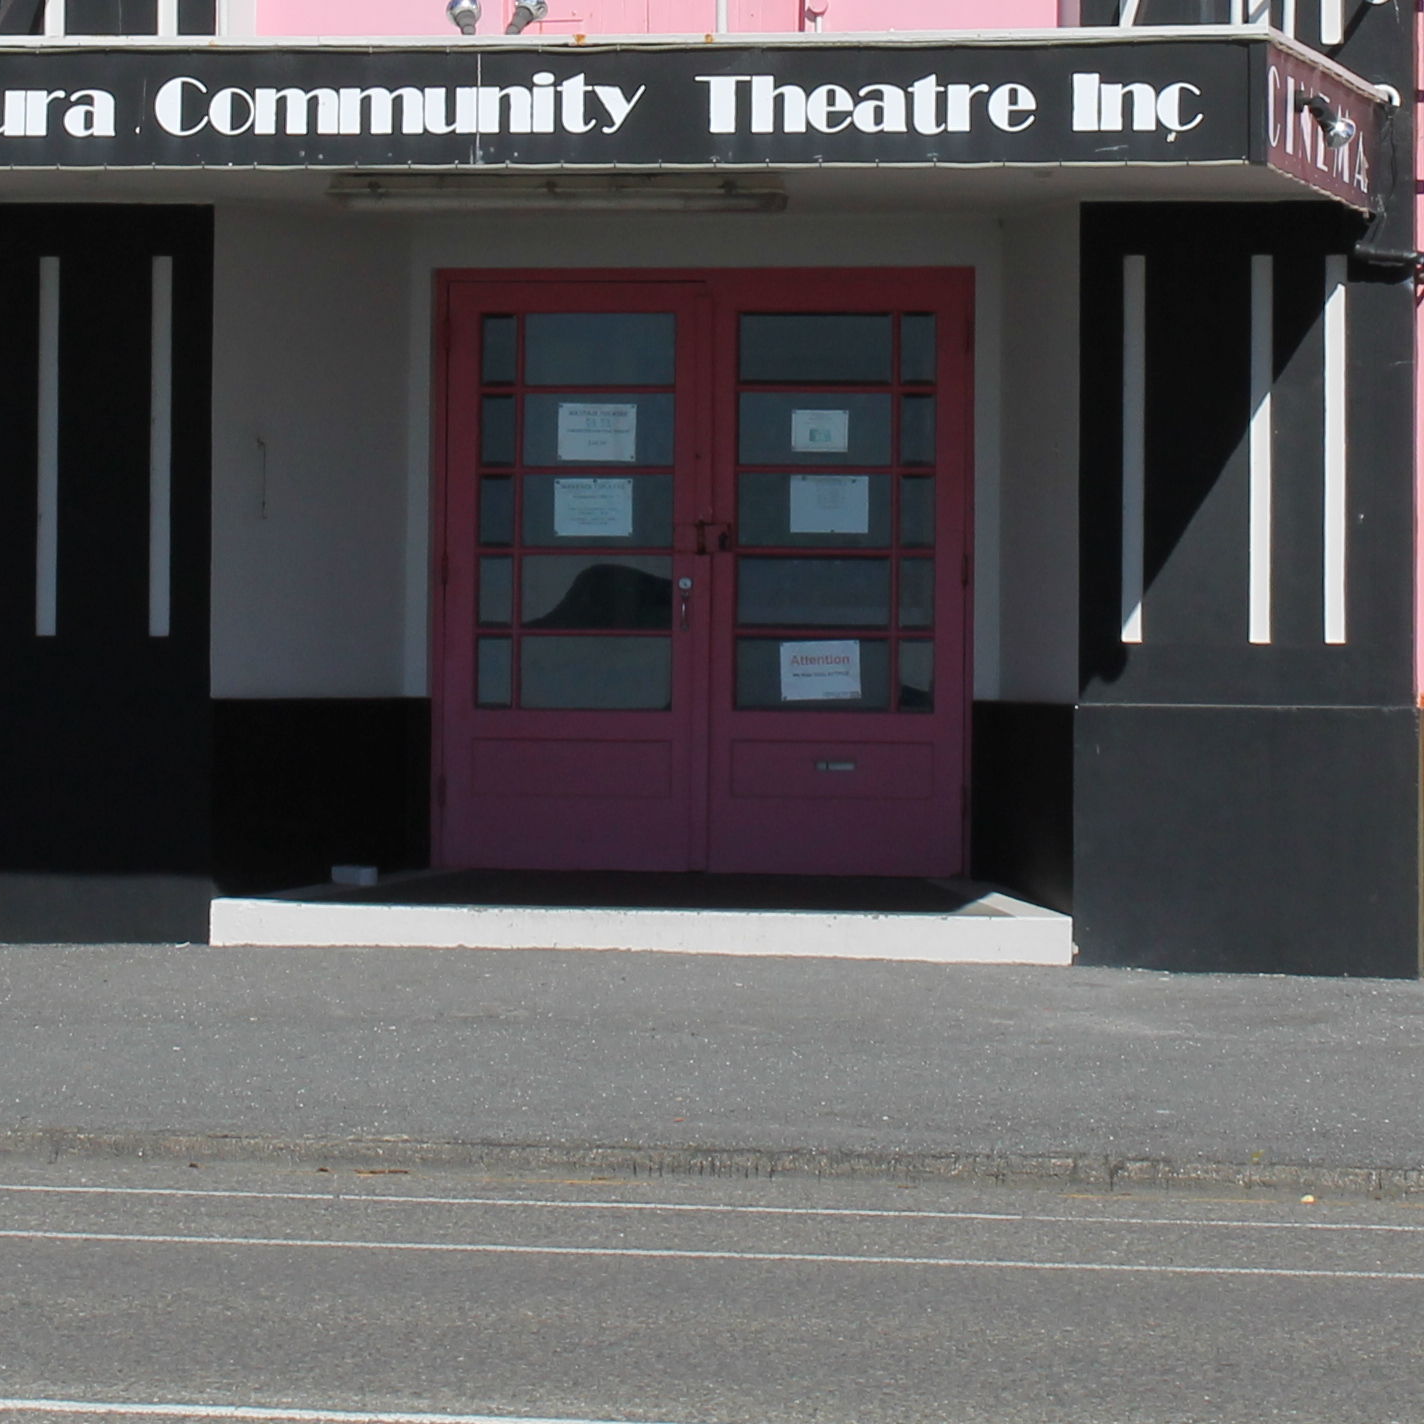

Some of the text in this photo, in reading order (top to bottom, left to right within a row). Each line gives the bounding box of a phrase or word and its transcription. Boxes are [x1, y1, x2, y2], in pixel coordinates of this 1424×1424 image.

[155, 71, 646, 137] Community
[694, 72, 1037, 136] Theatre
[790, 655, 850, 666] Attention
